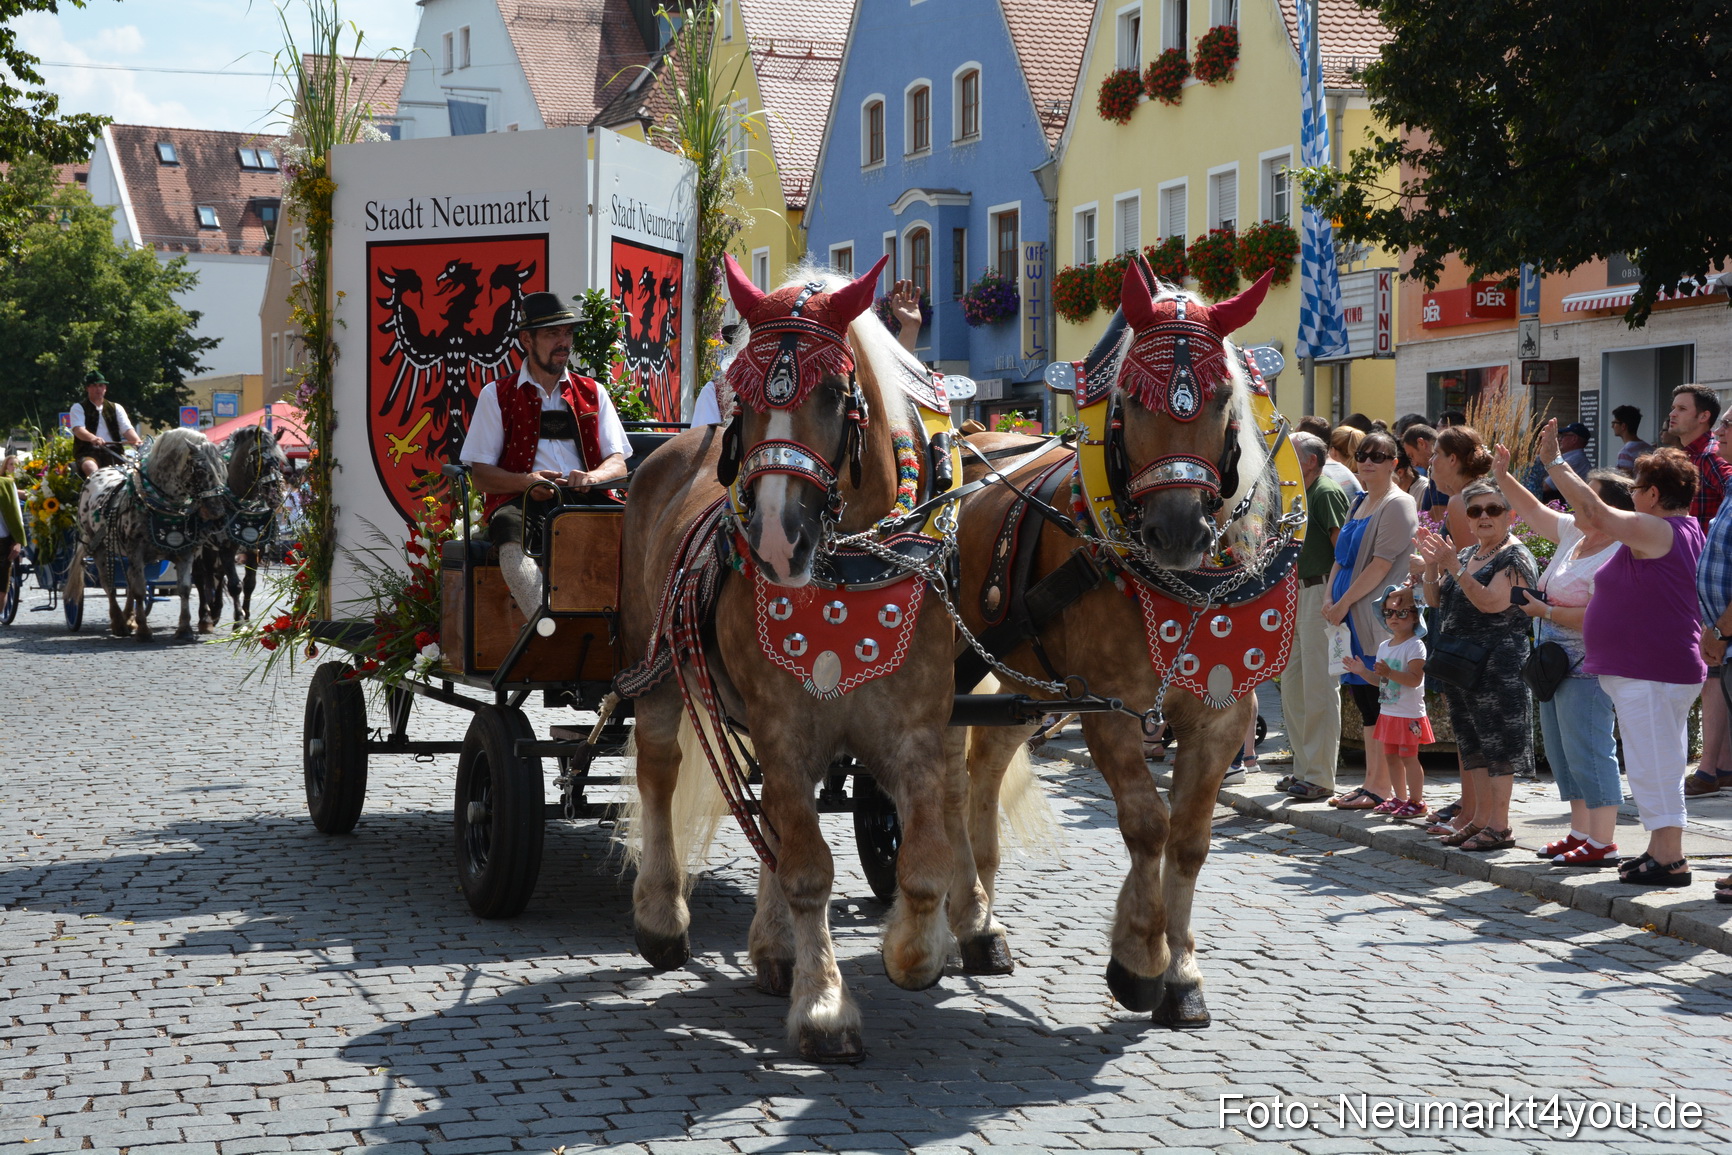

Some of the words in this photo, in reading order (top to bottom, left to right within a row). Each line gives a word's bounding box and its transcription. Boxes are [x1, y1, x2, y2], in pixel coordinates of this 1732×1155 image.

[365, 198, 424, 232] Stadt
[432, 190, 550, 228] Neumarkt
[611, 194, 637, 228] Stadt
[638, 203, 685, 243] Neumarkt
[1025, 244, 1044, 261] CAFÉ
[1476, 290, 1506, 307] DER
[1524, 262, 1537, 307] P
[1026, 264, 1042, 349] WITTL
[1378, 273, 1389, 351] KINO
[1423, 303, 1441, 323] DER
[1553, 329, 1559, 341] 15
